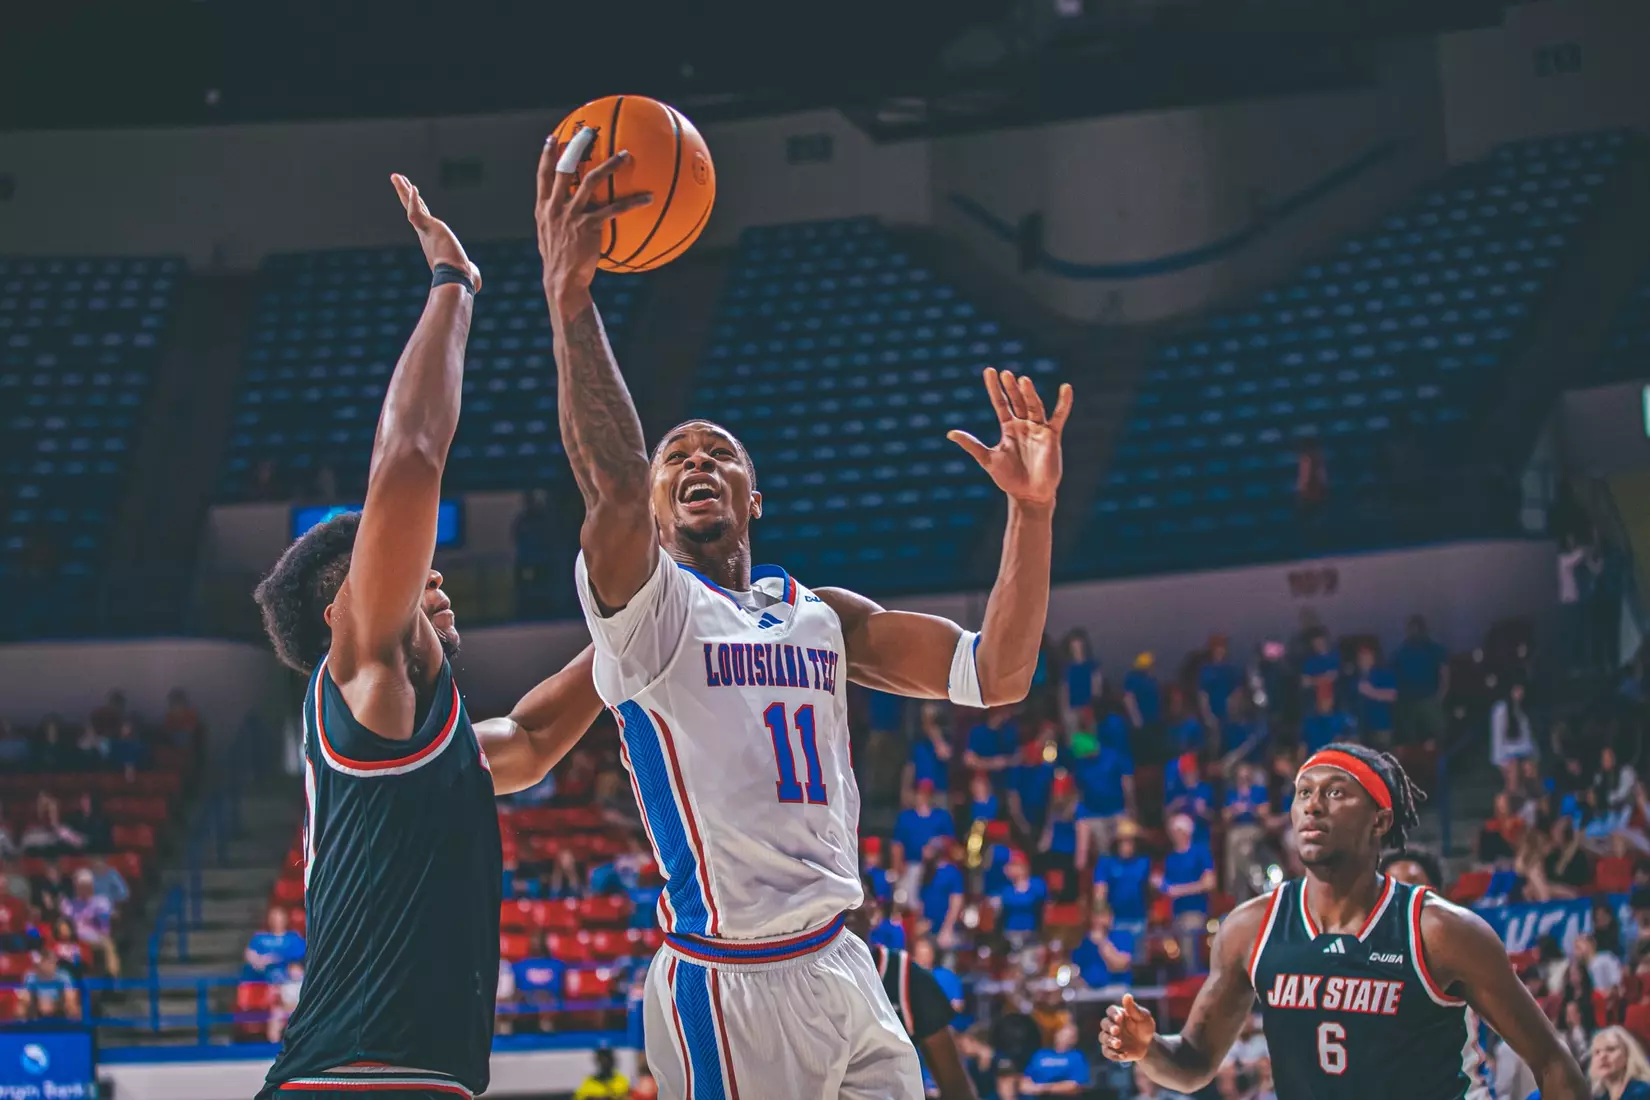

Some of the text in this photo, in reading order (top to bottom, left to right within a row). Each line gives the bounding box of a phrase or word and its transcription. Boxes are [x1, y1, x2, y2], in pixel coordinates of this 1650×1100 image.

[703, 642, 809, 688] LOUISIANA
[763, 701, 829, 805] 11
[1267, 973, 1405, 1015] JAX STATE
[1316, 1021, 1348, 1075] 6
